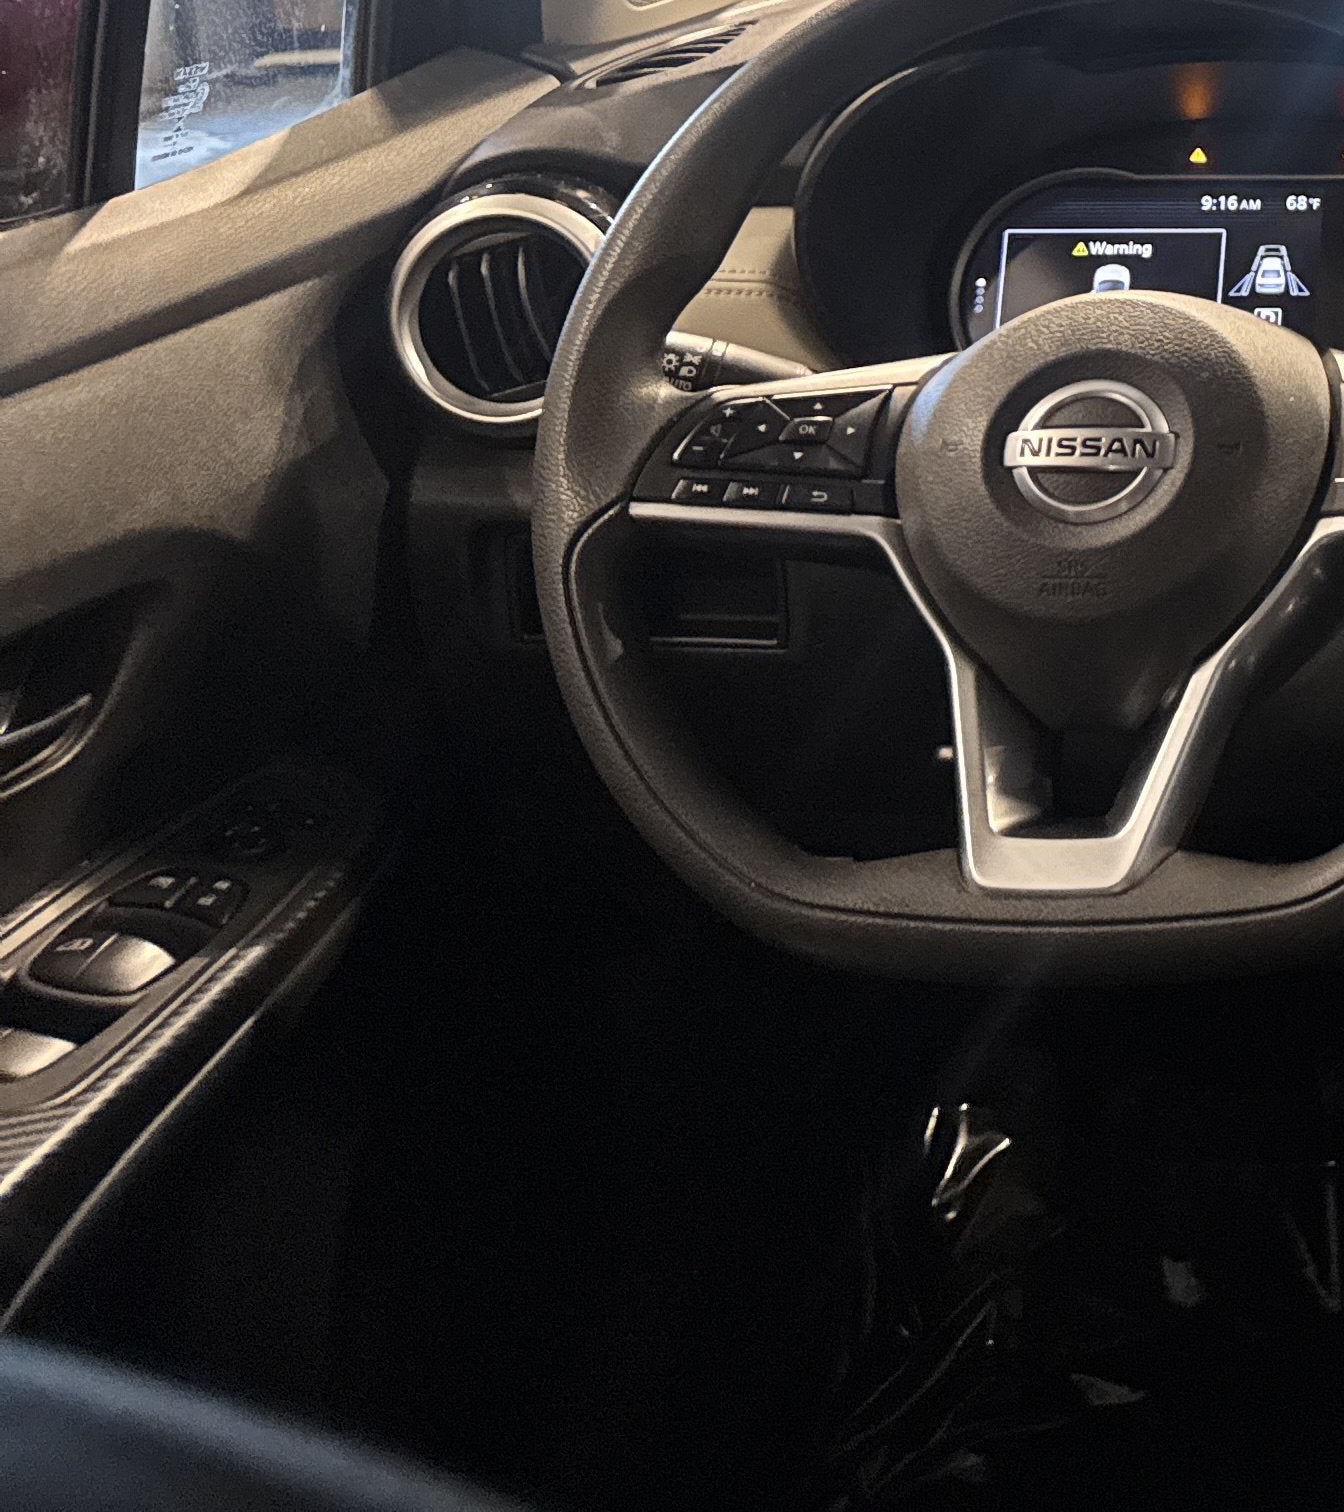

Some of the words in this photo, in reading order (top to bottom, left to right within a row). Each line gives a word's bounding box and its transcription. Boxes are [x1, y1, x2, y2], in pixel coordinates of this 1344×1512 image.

[1089, 240, 1153, 258] Warning
[798, 423, 817, 436] OK
[1019, 436, 1160, 459] NISSAN
